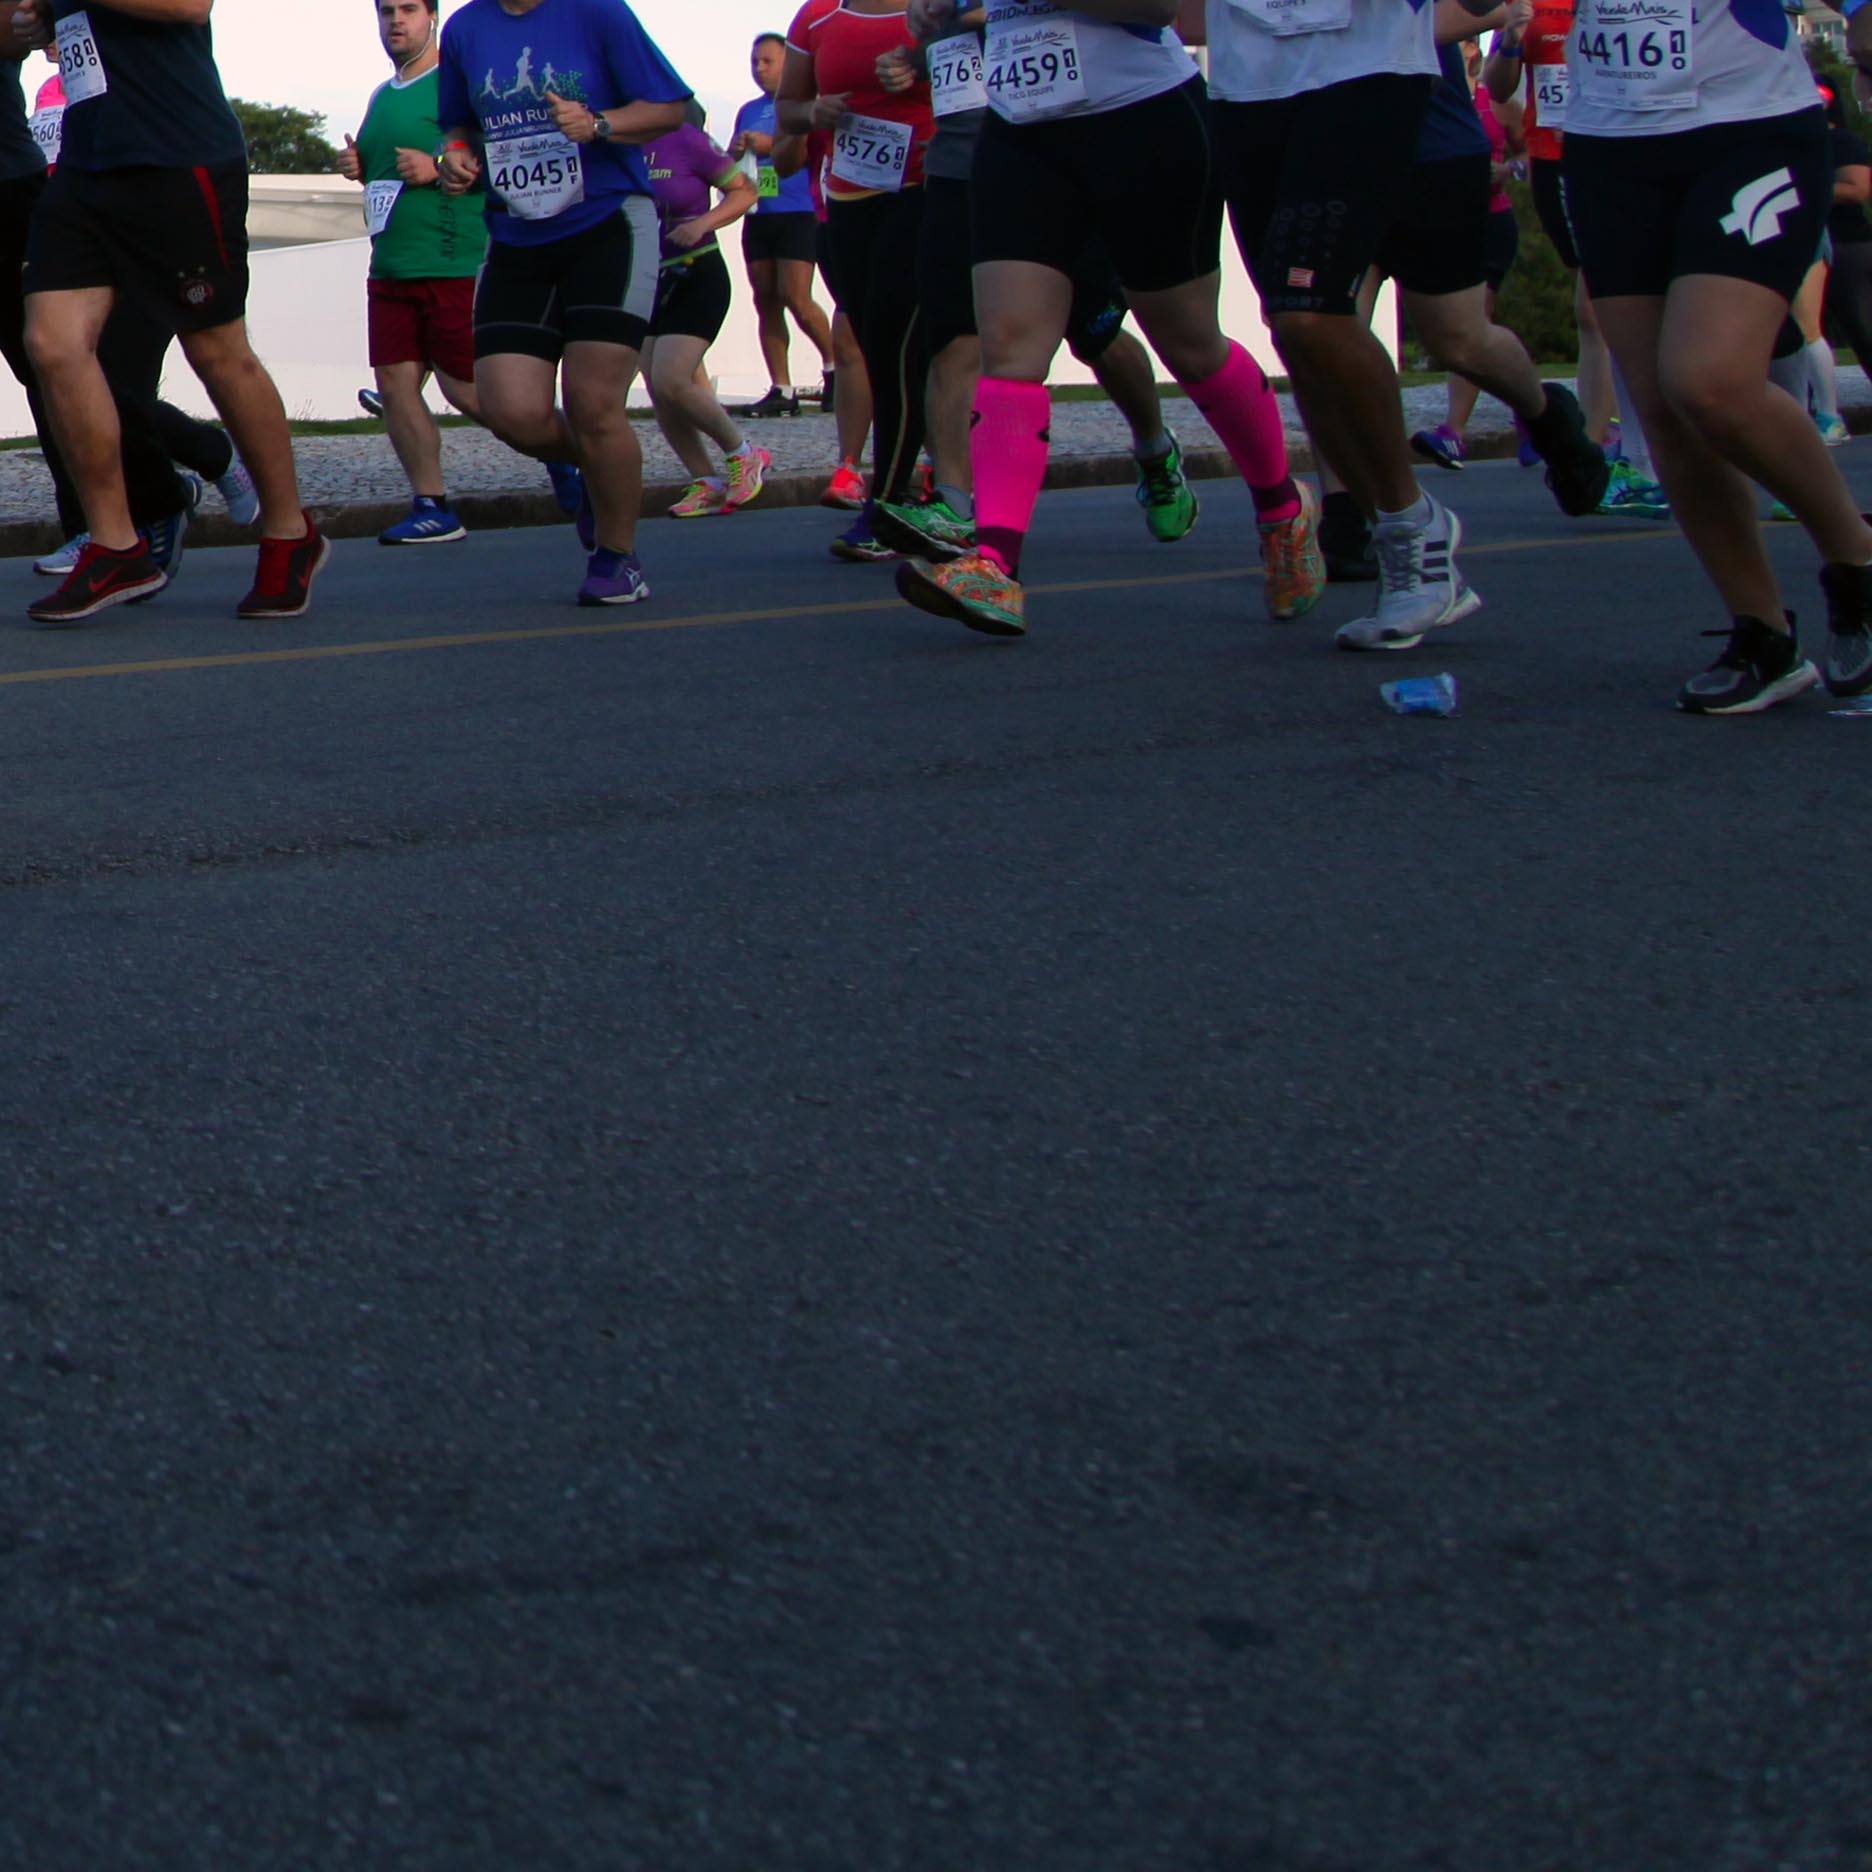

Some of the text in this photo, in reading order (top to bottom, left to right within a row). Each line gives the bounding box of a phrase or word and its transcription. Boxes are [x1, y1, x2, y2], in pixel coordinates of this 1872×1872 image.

[1578, 30, 1663, 67] 4416
[986, 52, 1059, 93] 4459
[837, 132, 890, 164] 4576
[494, 159, 564, 192] 4045
